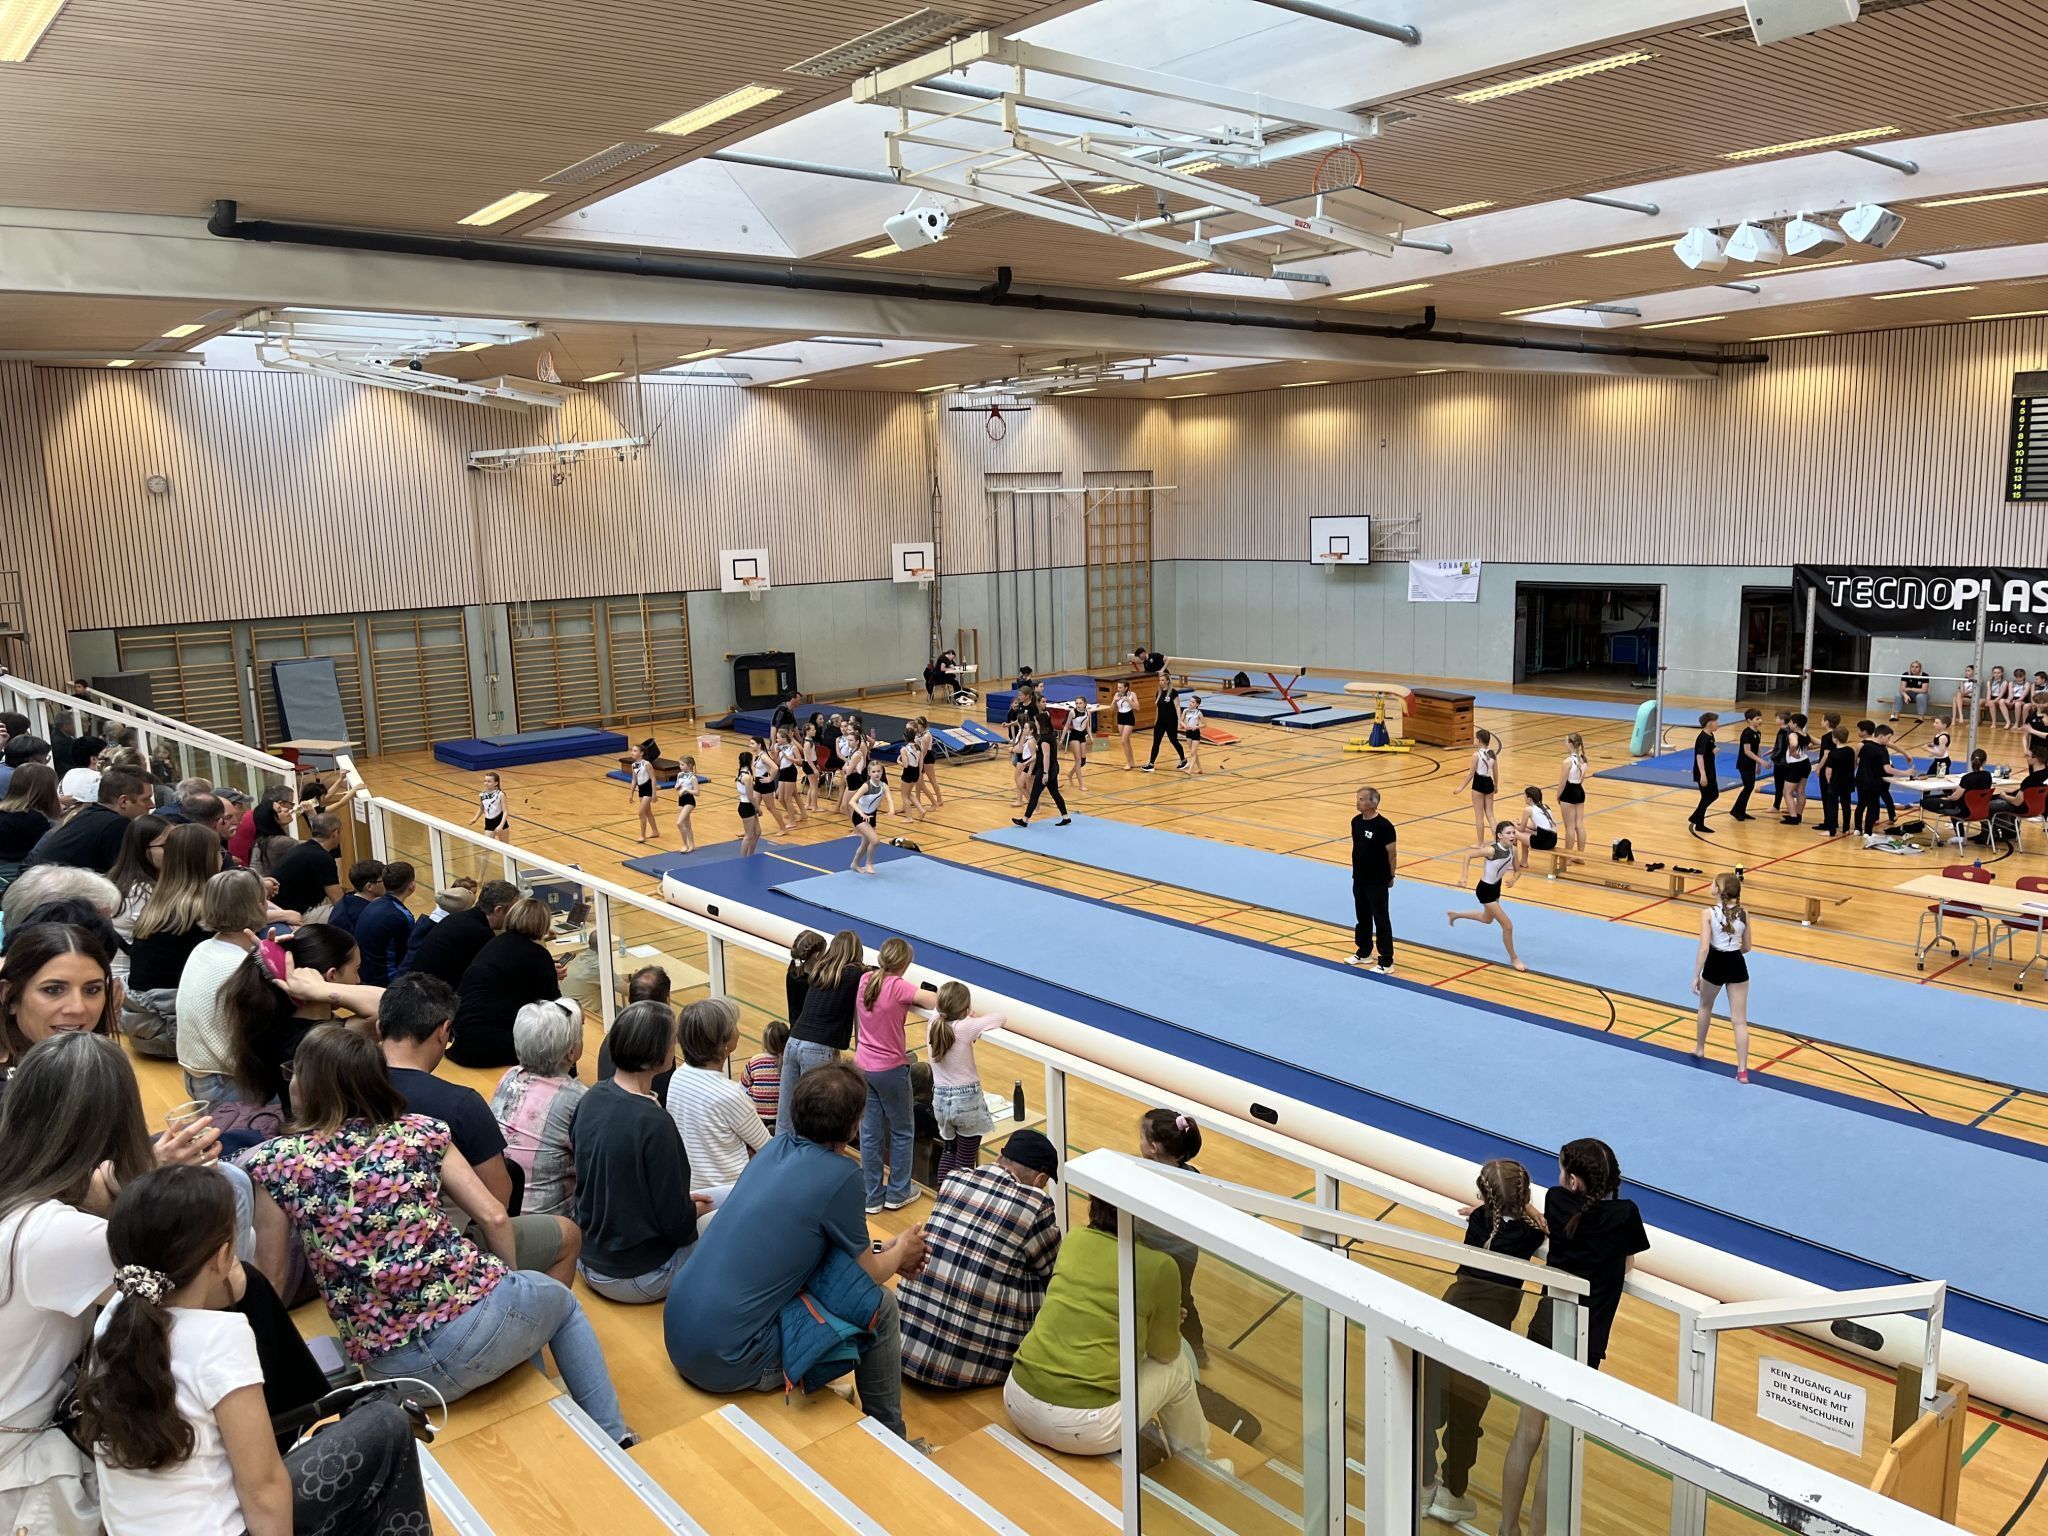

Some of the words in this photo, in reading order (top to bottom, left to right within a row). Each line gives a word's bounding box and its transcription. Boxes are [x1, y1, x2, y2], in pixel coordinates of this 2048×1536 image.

[1990, 620, 2032, 635] inject
[1771, 1367, 1790, 1379] KEIN
[1793, 1375, 1831, 1393] ZUGANG
[1833, 1390, 1852, 1400] AUF
[1774, 1381, 1787, 1391] DIE
[1790, 1386, 1827, 1406] TRIBÜNE
[1831, 1401, 1848, 1412] MIT
[1766, 1390, 1854, 1429] STRASSENSCHUHEN!
